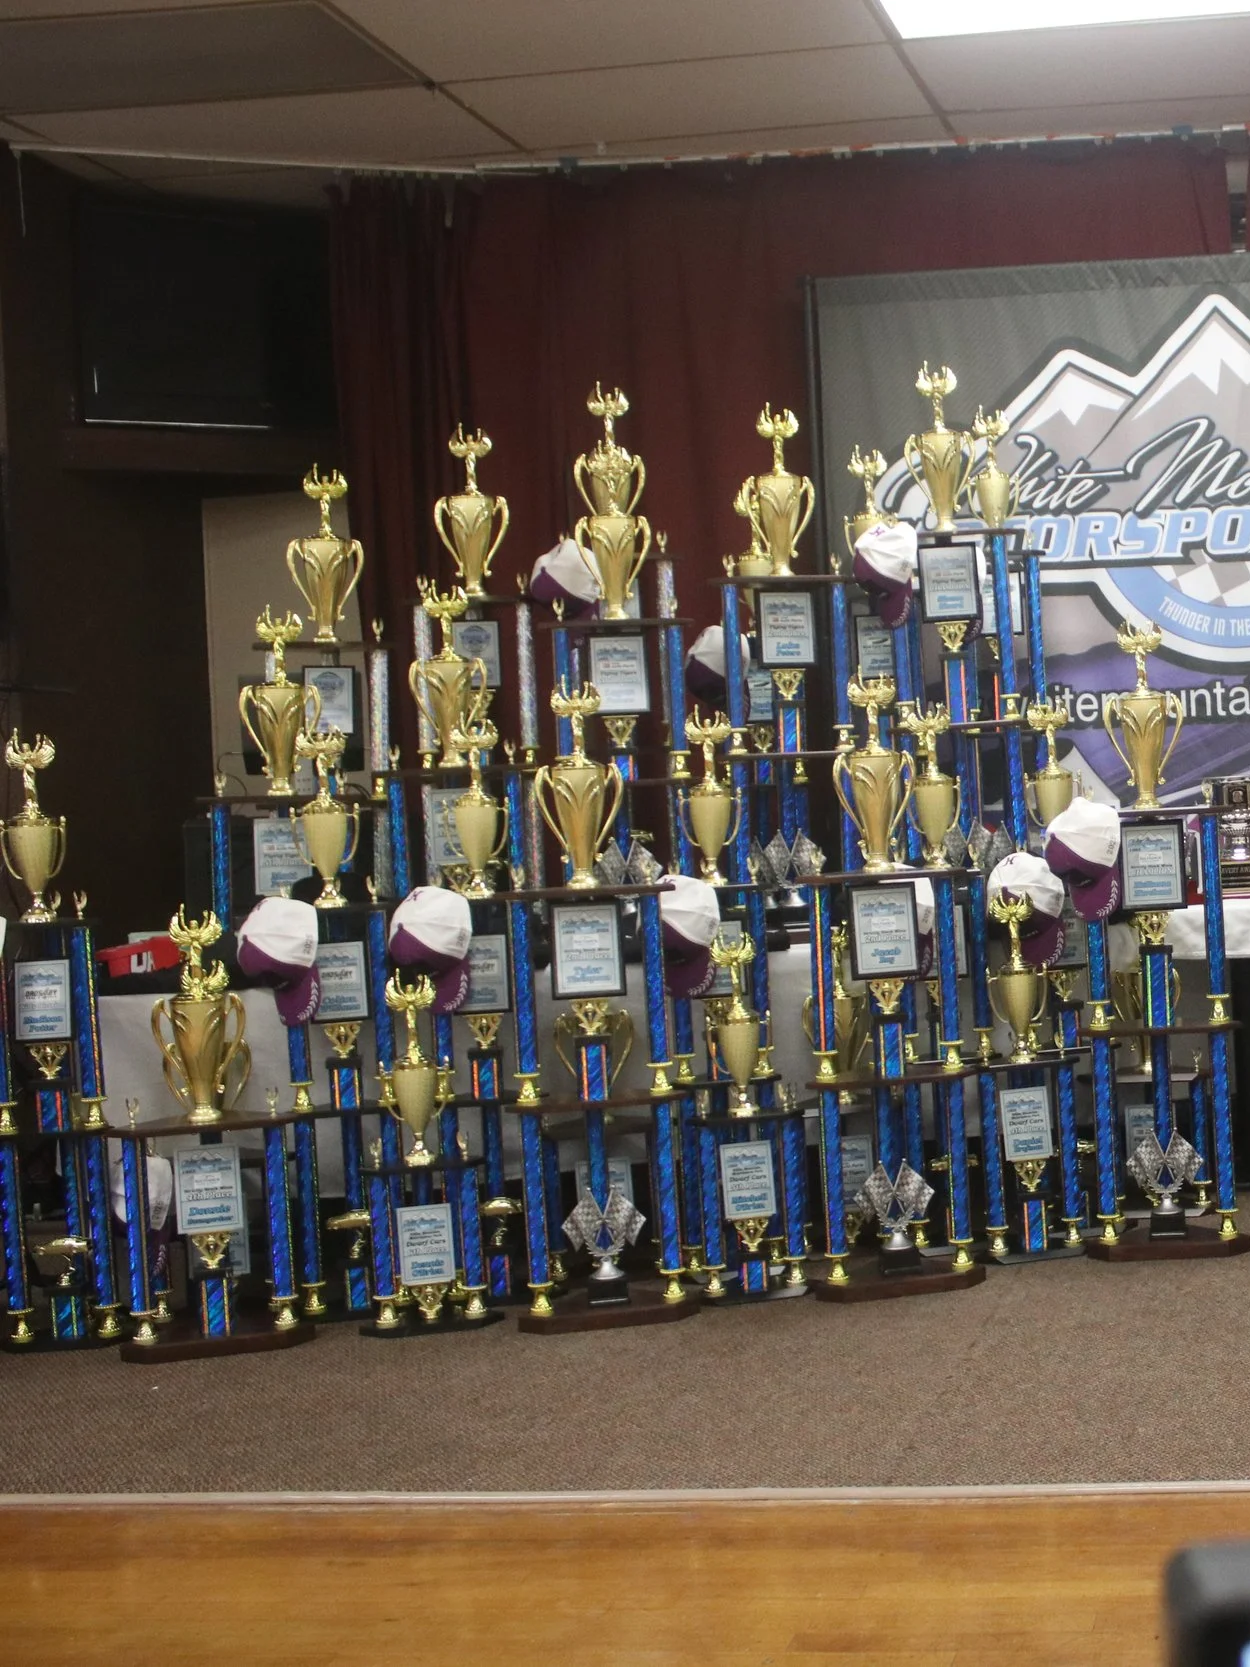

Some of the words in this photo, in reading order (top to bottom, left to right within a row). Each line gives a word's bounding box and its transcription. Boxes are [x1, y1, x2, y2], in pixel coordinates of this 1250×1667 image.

[1158, 596, 1210, 634] THUNDER
[1213, 618, 1226, 636] IN
[1230, 618, 1250, 636] THE
